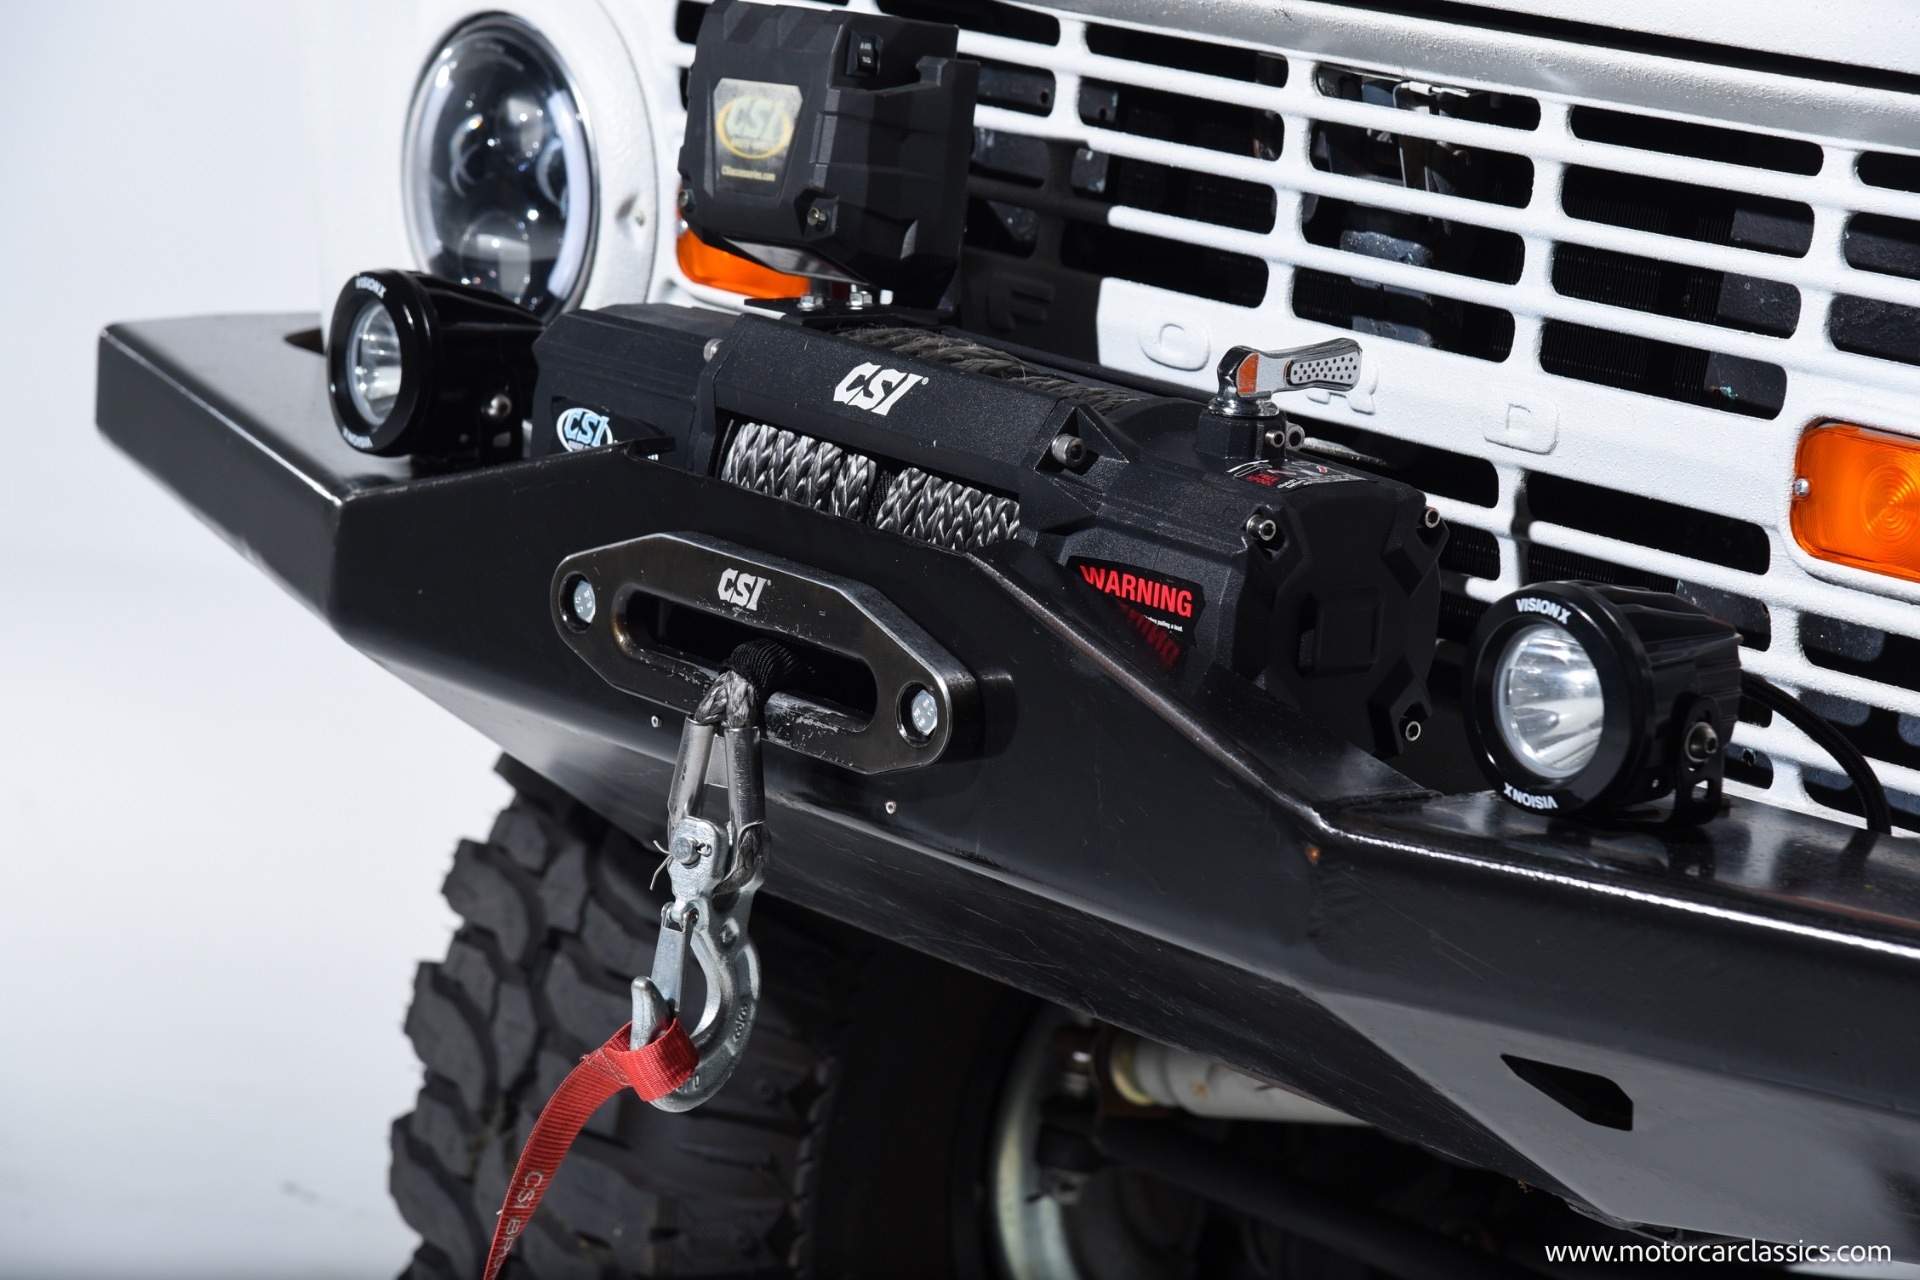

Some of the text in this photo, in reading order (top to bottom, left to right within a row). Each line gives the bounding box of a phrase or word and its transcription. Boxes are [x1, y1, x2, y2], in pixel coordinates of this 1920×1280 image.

[725, 96, 787, 140] CSI
[833, 361, 924, 416] CSI
[564, 410, 610, 448] CSI
[717, 567, 768, 612] CSI
[1080, 565, 1193, 618] WARNING
[514, 1170, 544, 1209] CSI
